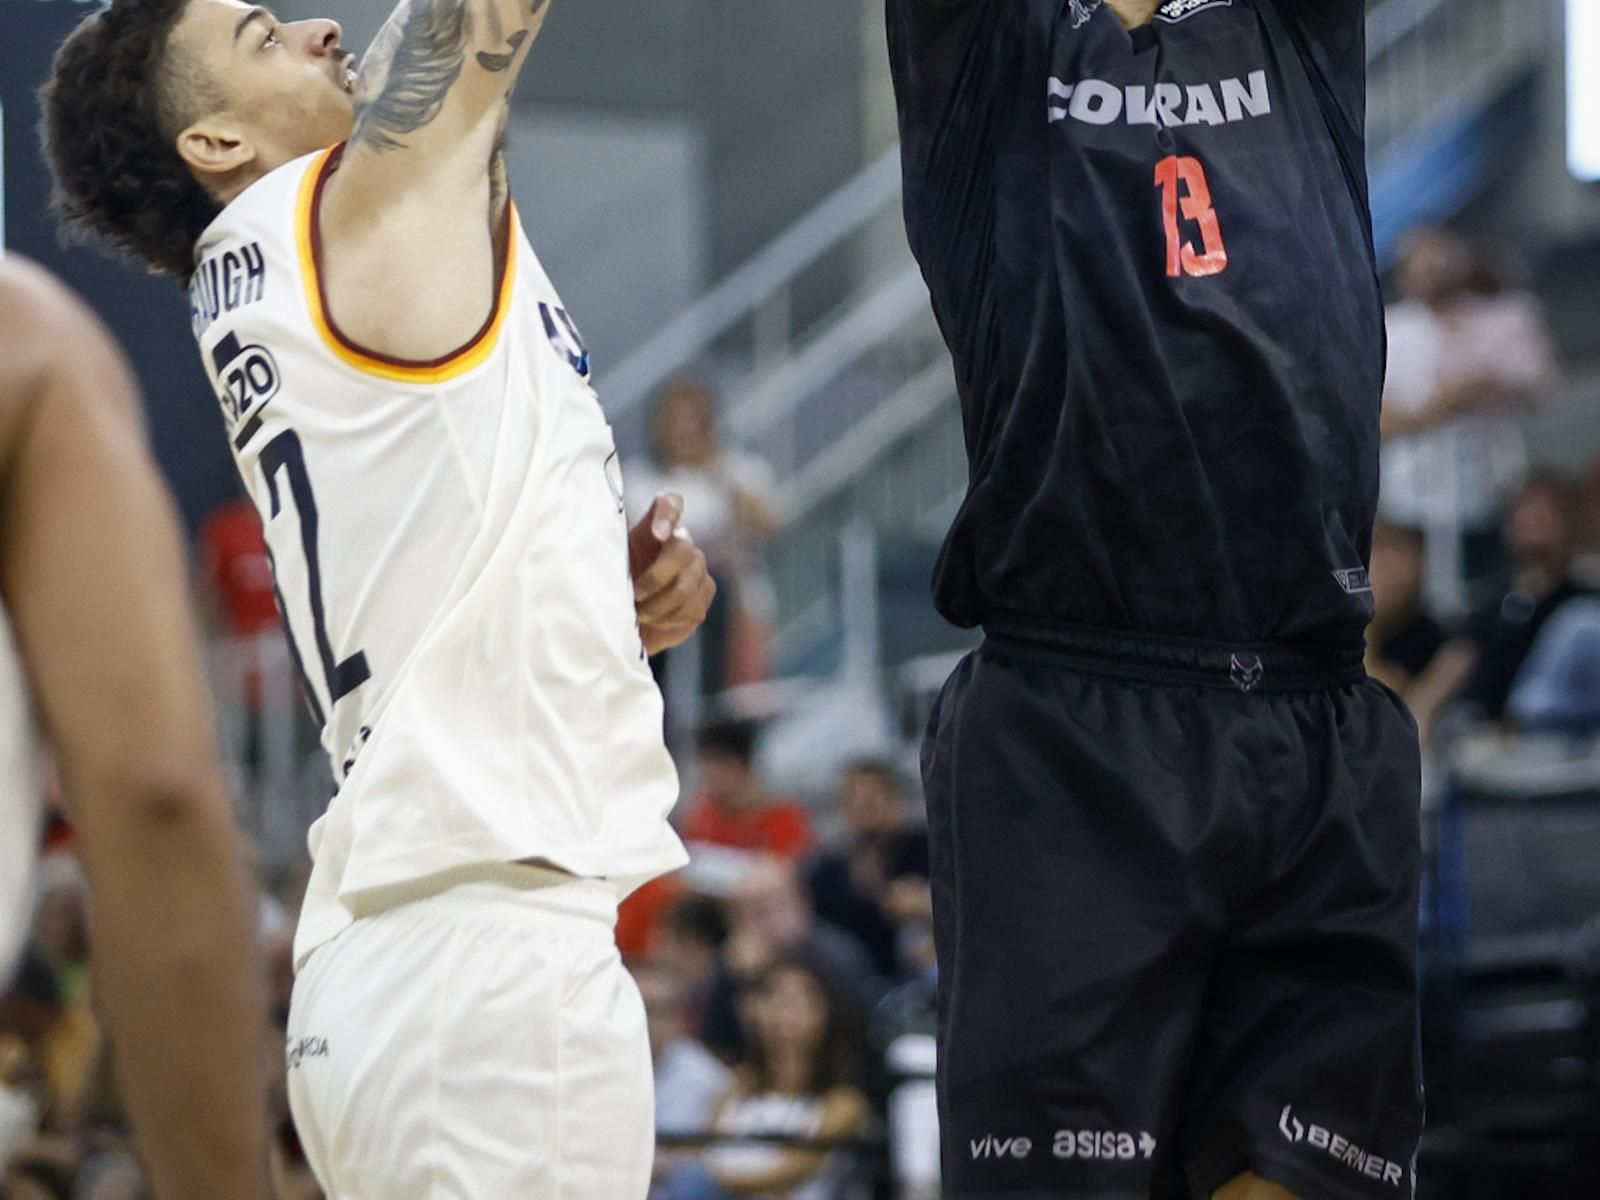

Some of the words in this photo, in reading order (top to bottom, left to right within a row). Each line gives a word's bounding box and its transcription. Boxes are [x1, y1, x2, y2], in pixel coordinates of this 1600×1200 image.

[1154, 154, 1229, 277] 13
[969, 1132, 1033, 1161] vive
[1052, 1129, 1136, 1161] asisa
[1306, 1123, 1403, 1187] BERNER
